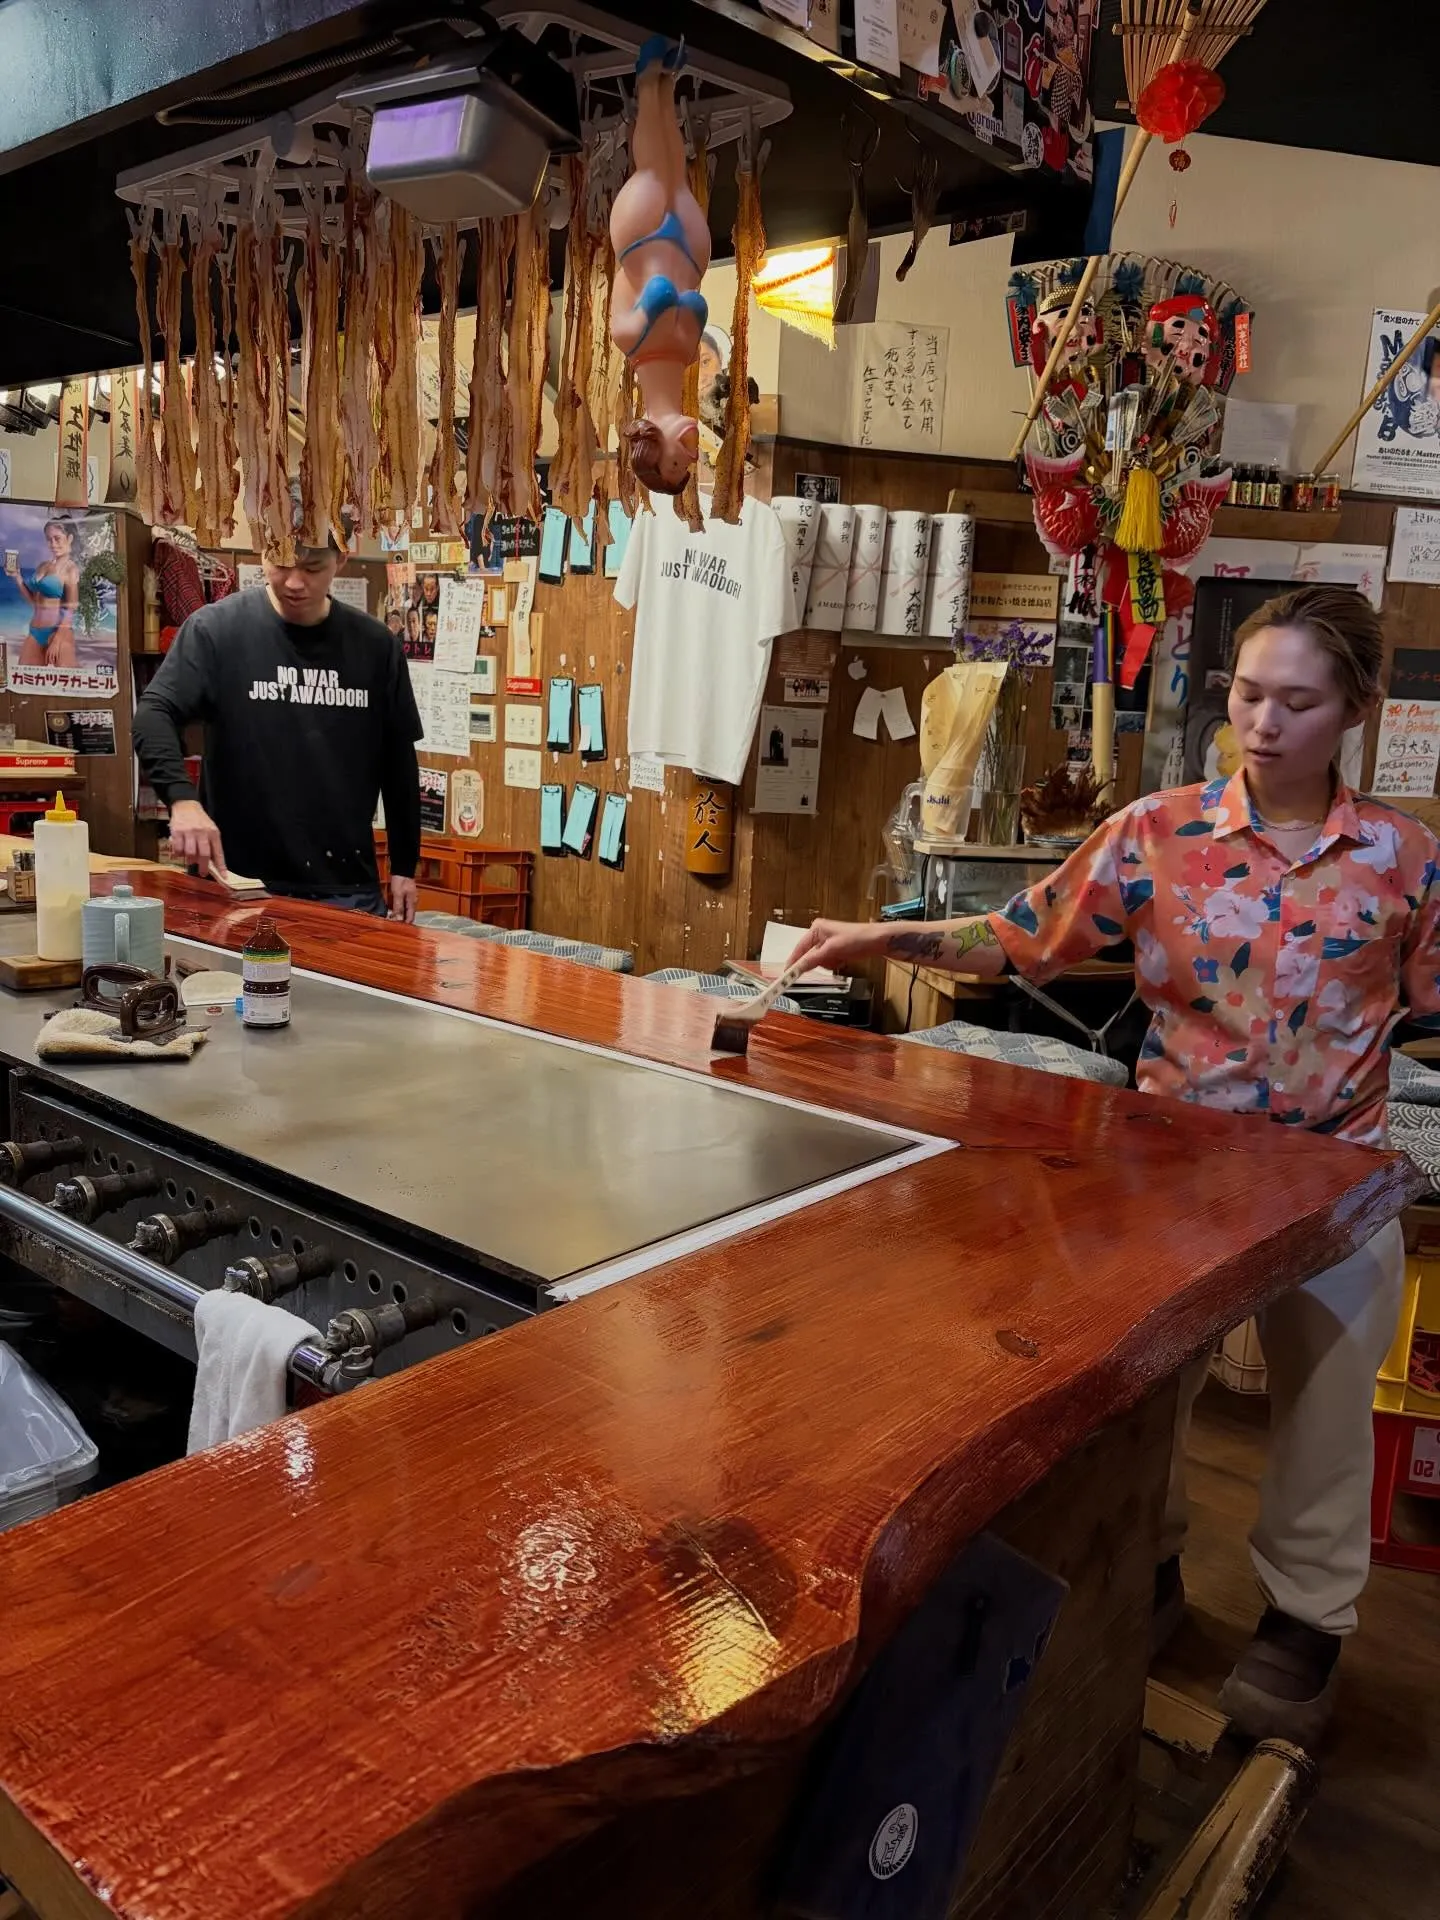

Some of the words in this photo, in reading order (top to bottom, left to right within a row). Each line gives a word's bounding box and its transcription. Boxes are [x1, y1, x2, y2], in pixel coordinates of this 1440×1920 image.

[660, 561, 690, 580] JUST
[699, 551, 727, 575] WAR
[277, 666, 298, 685] NO
[303, 668, 339, 689] WAR
[248, 681, 286, 701] JUST
[289, 684, 369, 708] AWAODORI
[15, 757, 48, 767] Supreme
